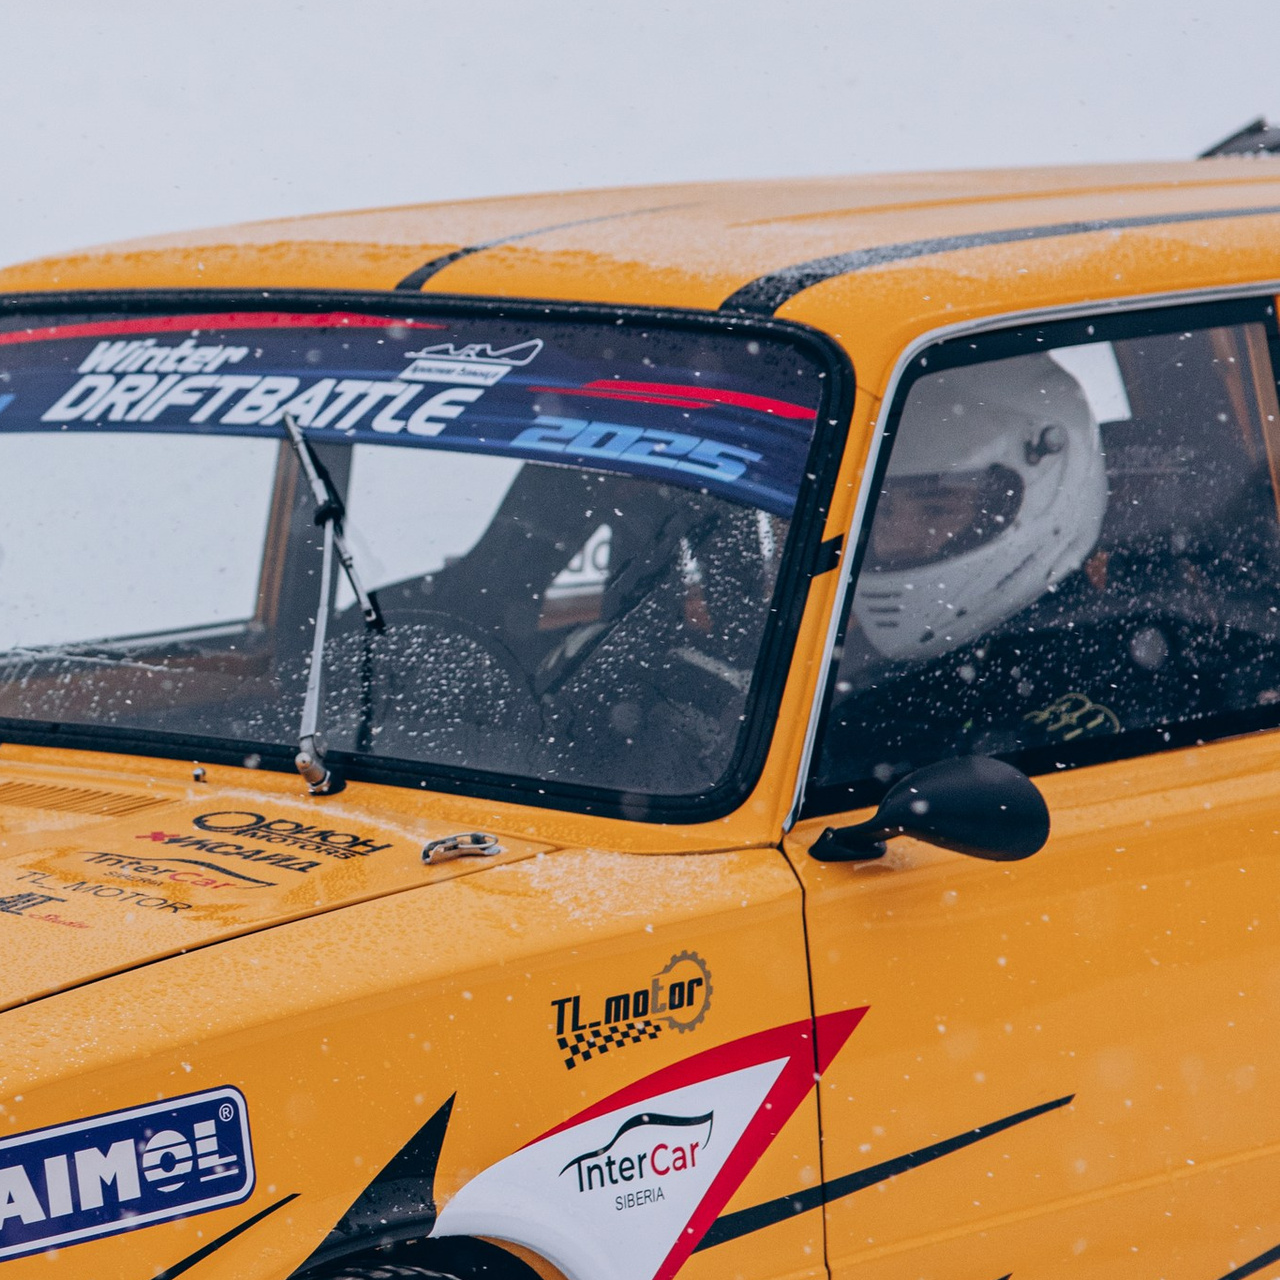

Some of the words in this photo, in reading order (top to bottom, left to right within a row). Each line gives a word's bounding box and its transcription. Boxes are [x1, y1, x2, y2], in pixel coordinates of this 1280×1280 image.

[78, 338, 249, 372] Winter
[509, 414, 764, 483] 2025
[247, 831, 357, 861] MOTORS
[83, 852, 236, 890] InterCar
[577, 1141, 700, 1193] InterCar
[615, 1186, 666, 1211] SIBERIA
